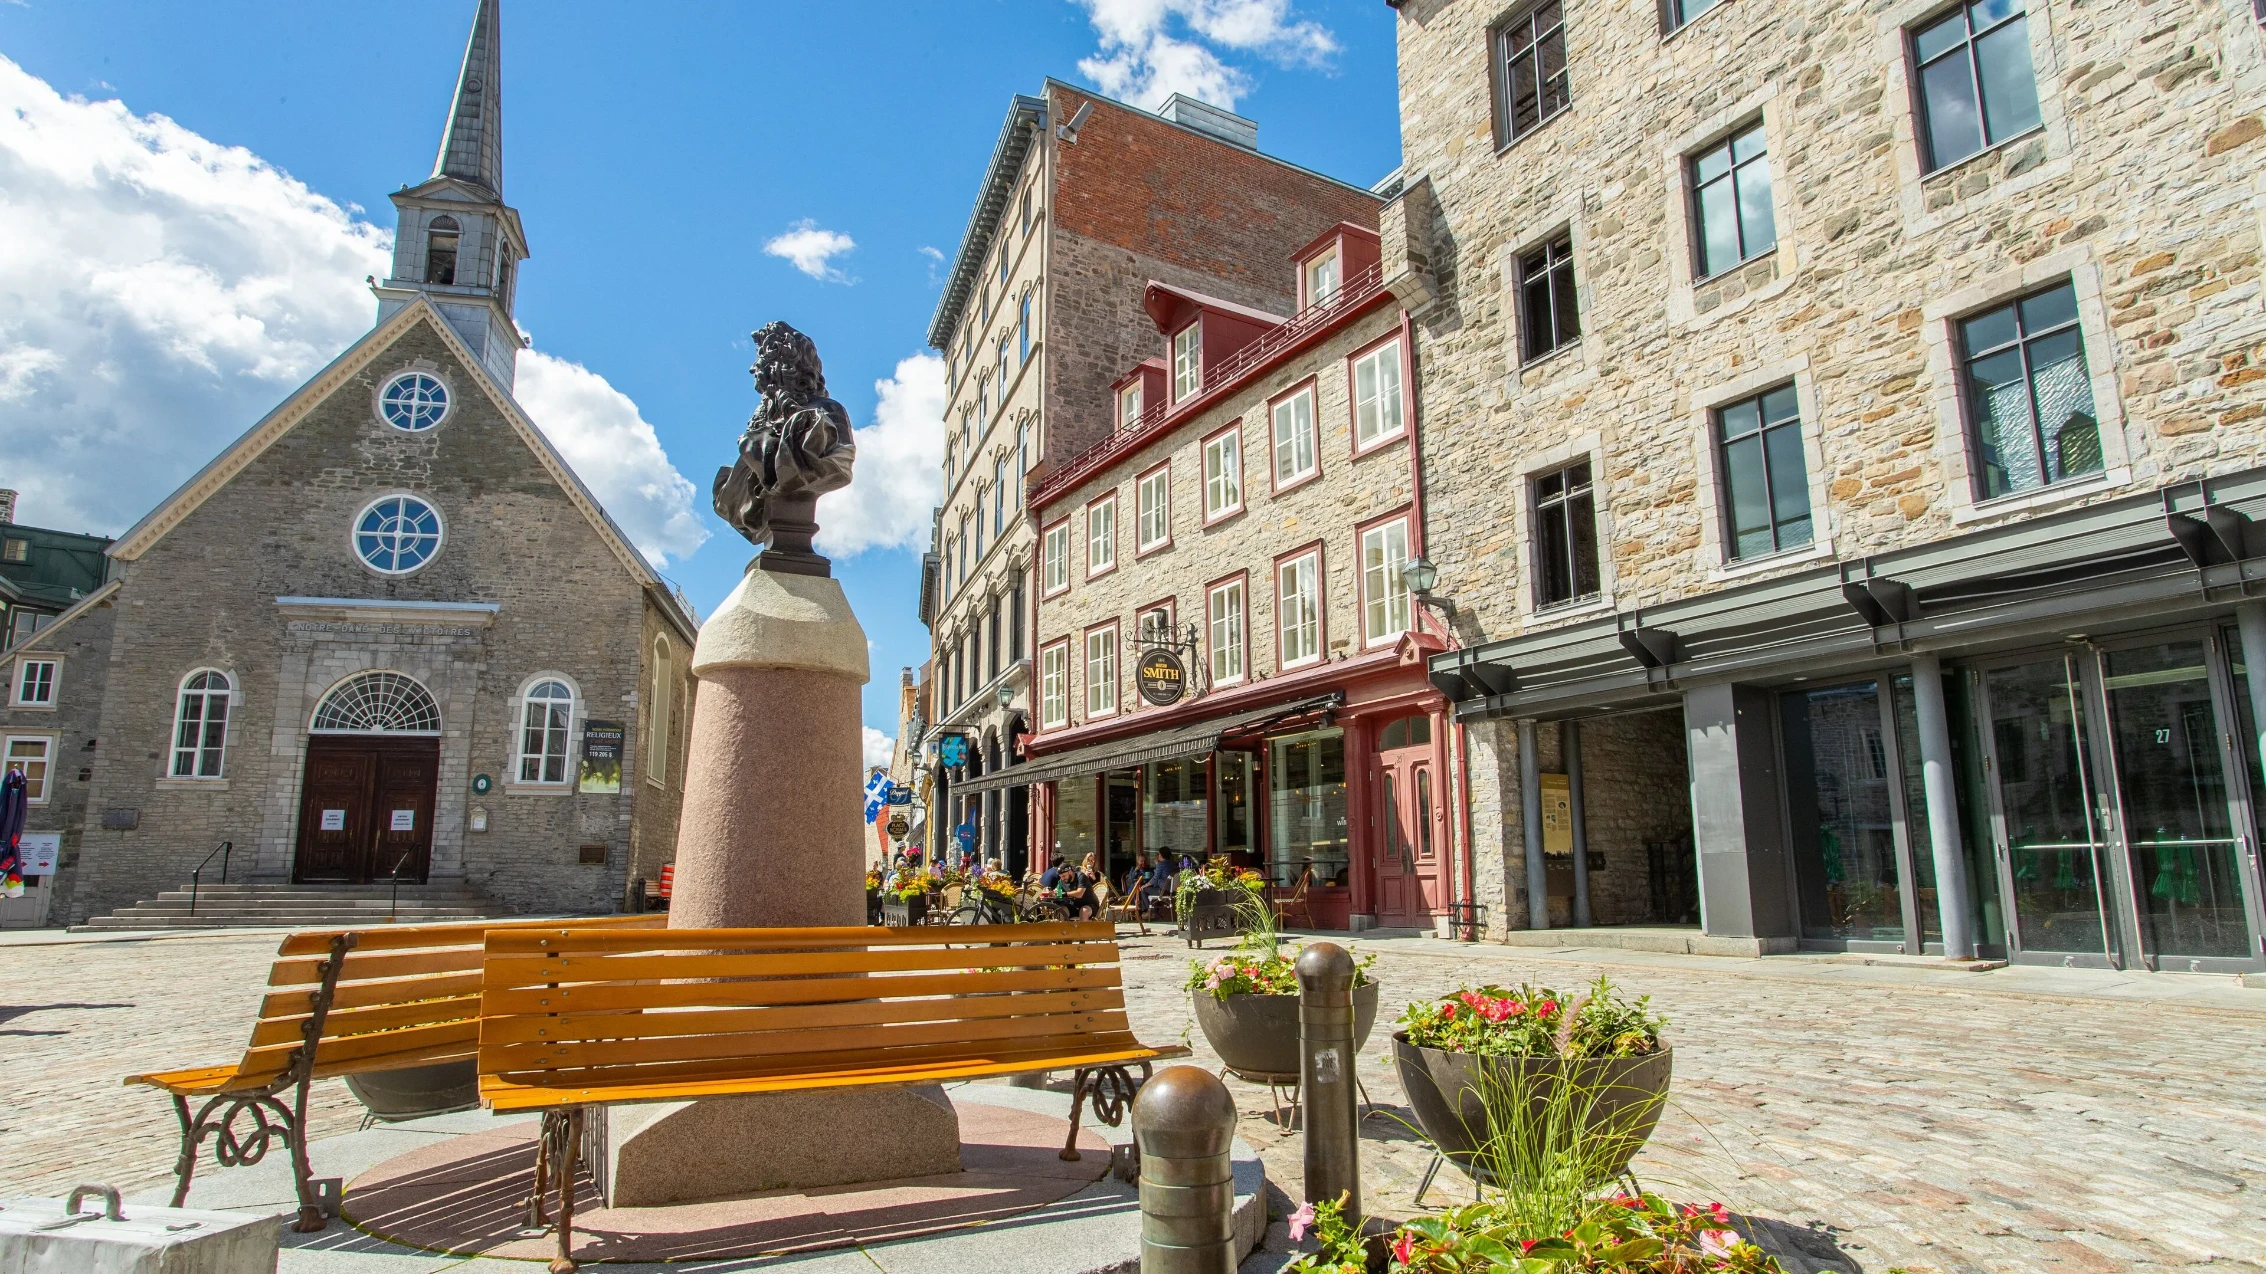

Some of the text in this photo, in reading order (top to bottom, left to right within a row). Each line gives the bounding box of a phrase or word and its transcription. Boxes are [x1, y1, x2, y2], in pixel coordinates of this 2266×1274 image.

[379, 626, 400, 634] DES
[1143, 667, 1179, 680] SMITH
[586, 731, 622, 739] RELIGIEUX
[2155, 728, 2170, 744] 27
